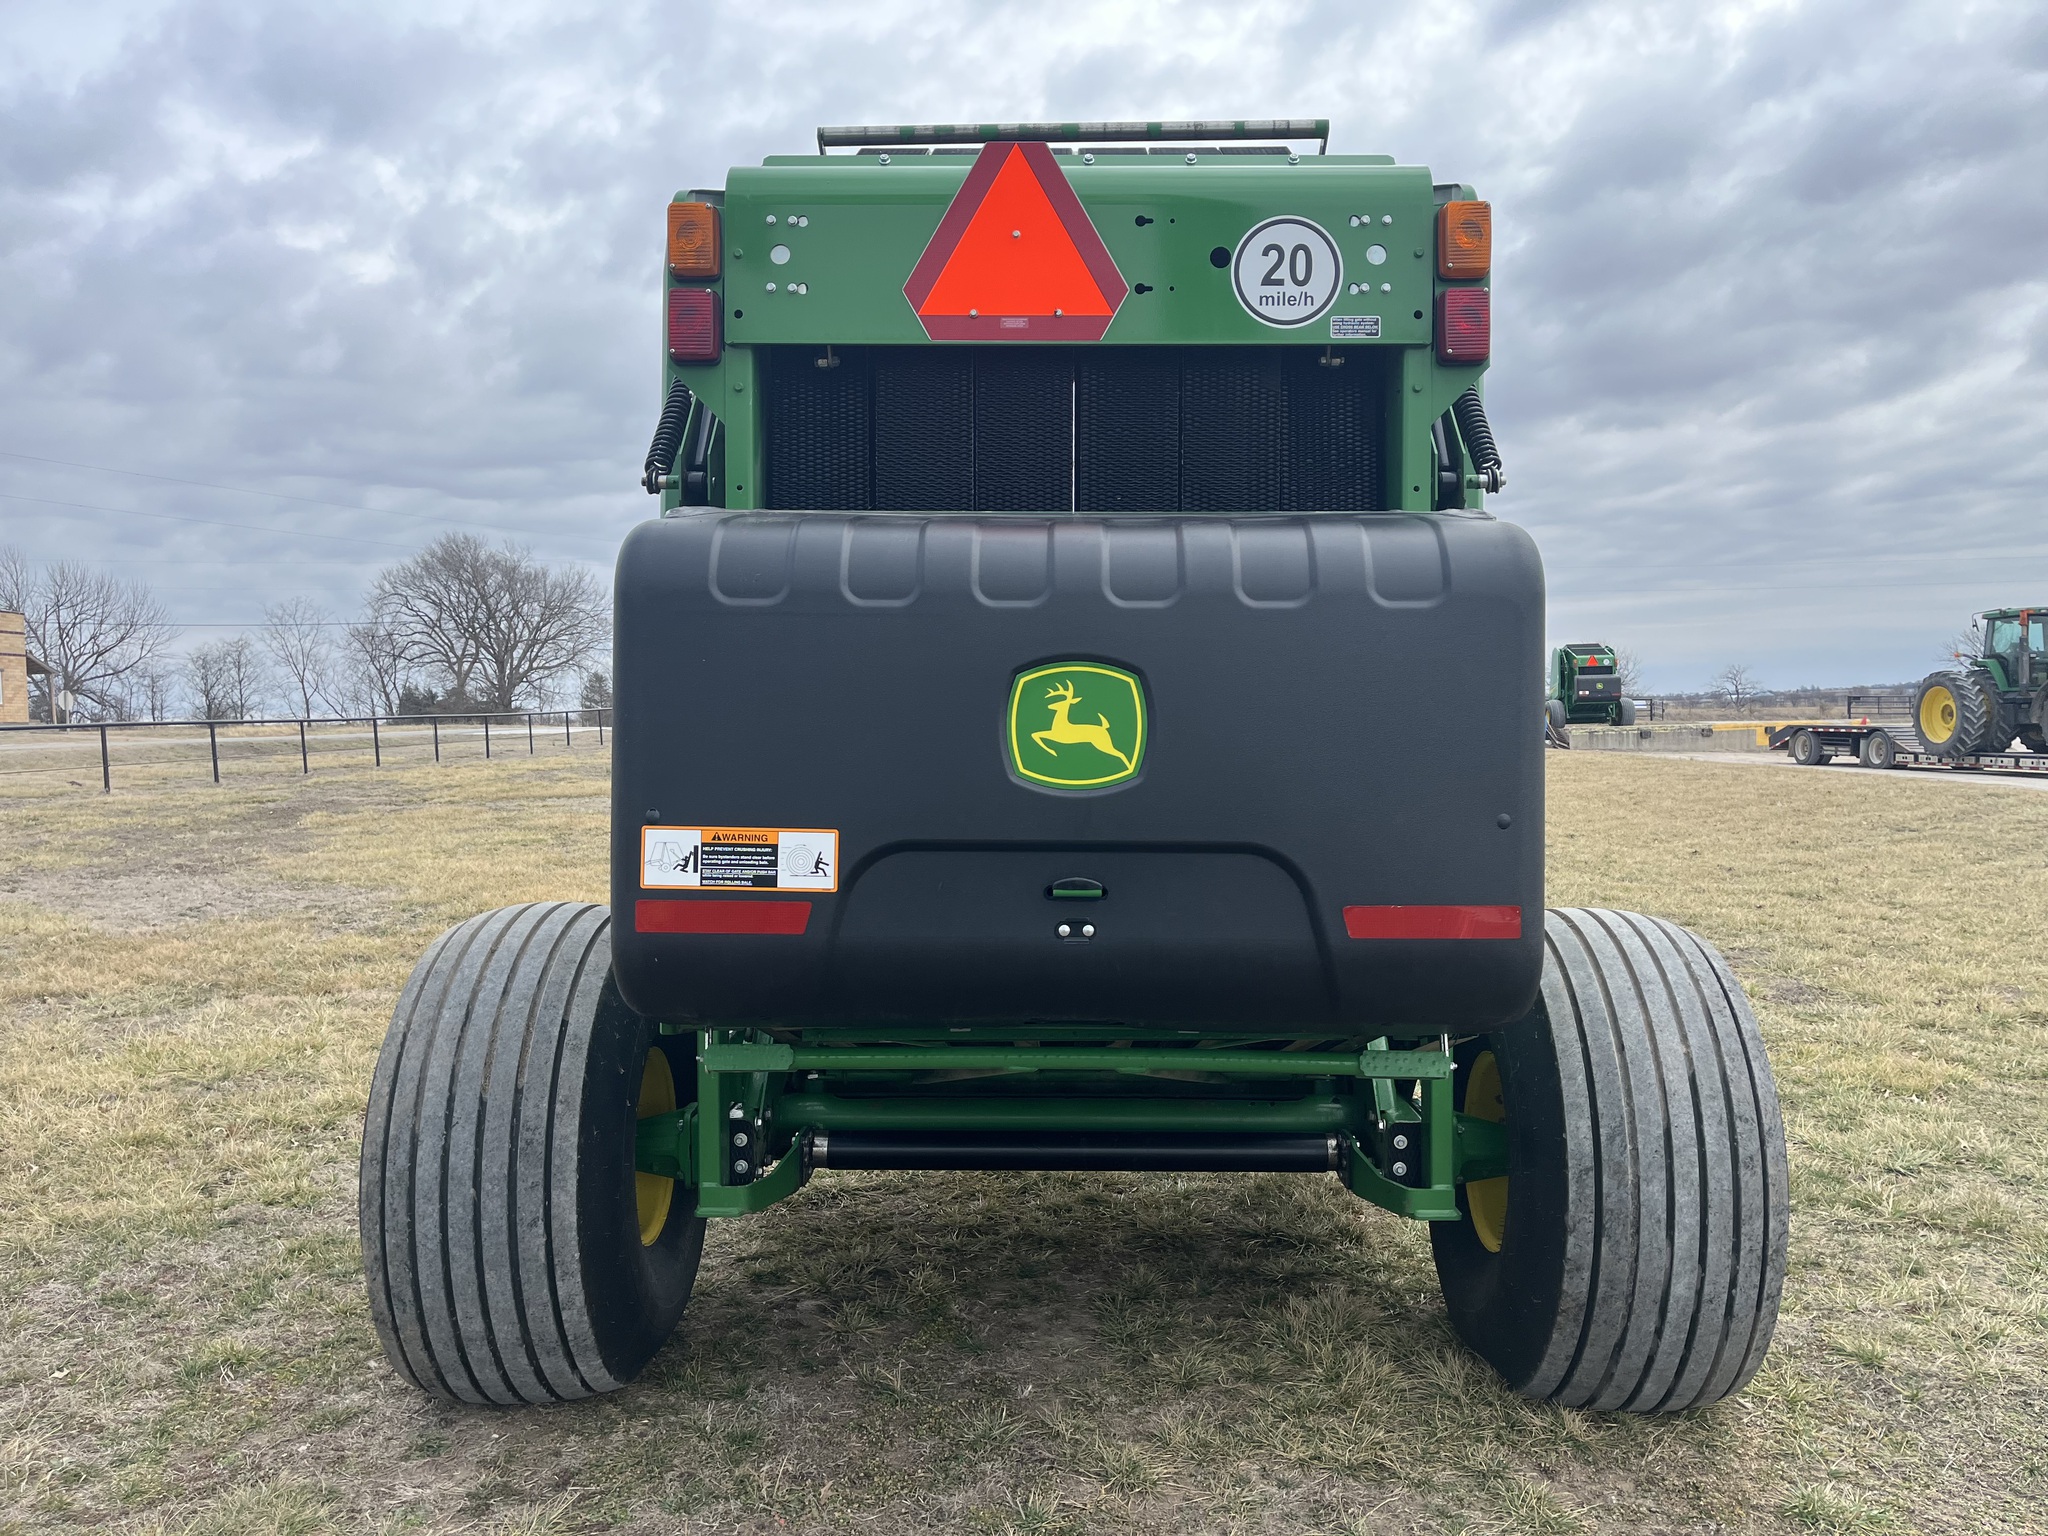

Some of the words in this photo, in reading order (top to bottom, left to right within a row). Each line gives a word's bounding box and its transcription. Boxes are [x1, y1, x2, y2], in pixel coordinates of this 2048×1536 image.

[1260, 243, 1313, 287] 20
[1259, 291, 1314, 306] mile/h
[721, 832, 768, 842] WARNING
